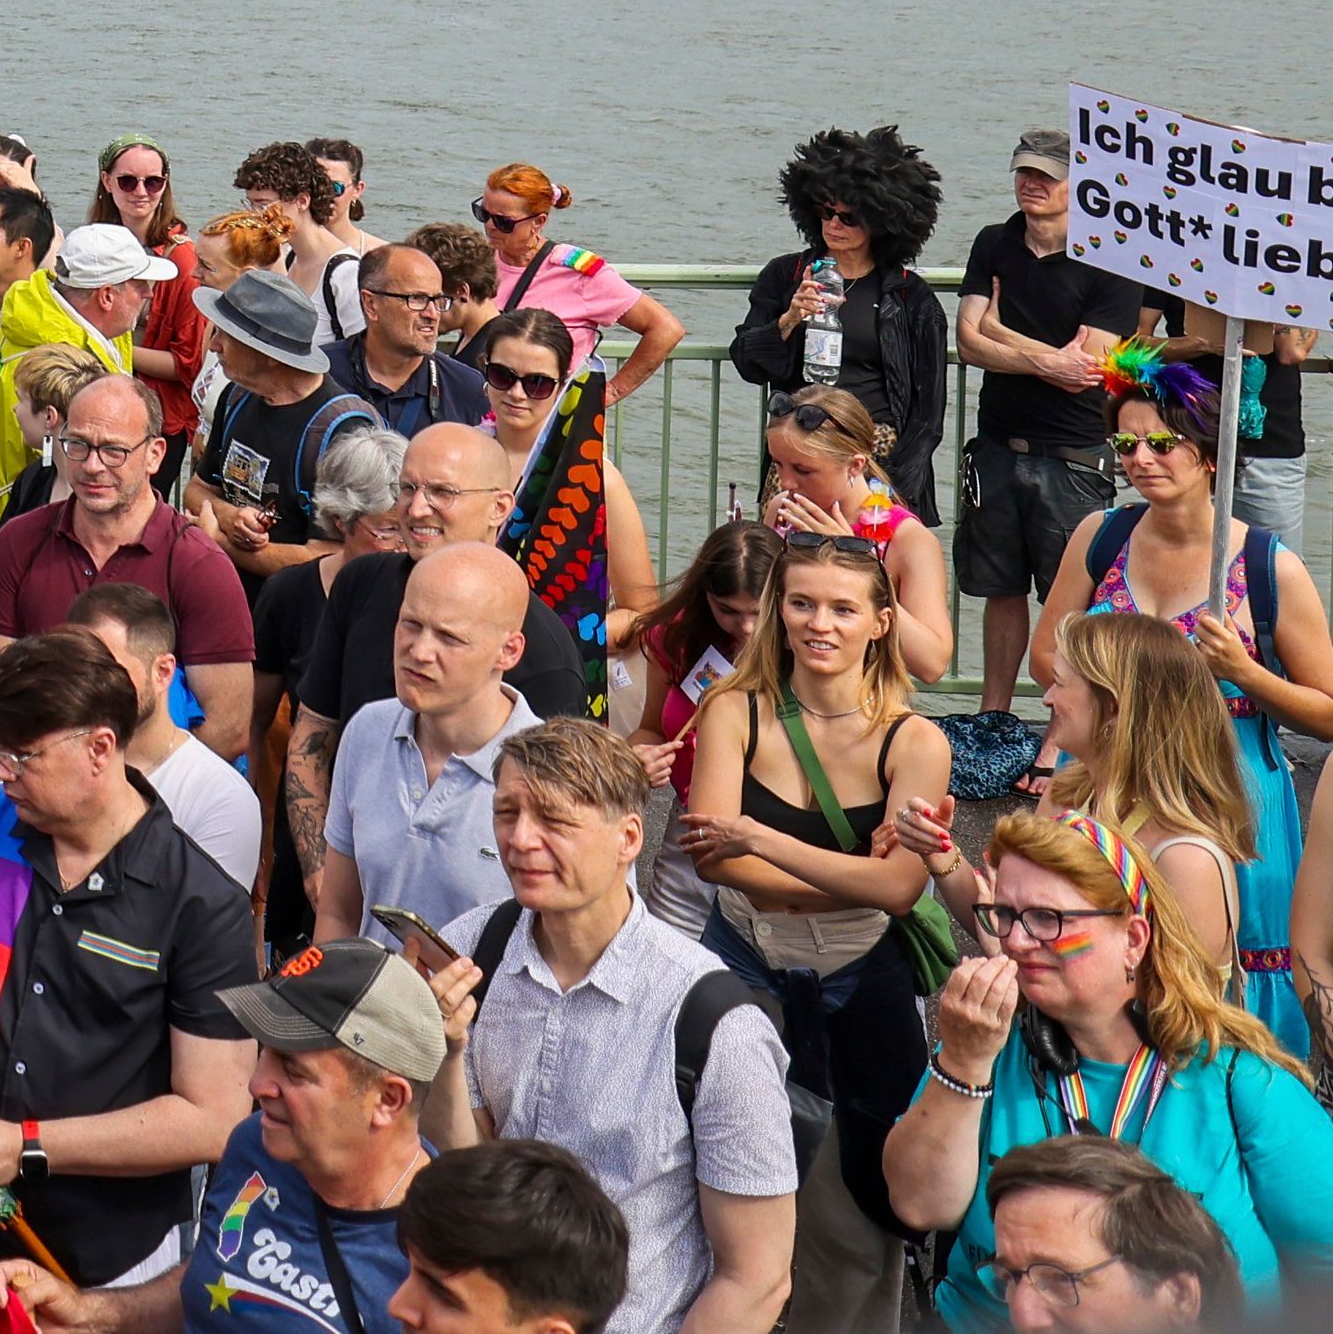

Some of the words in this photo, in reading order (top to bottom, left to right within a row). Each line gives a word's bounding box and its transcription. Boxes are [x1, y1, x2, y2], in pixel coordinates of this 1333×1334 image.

[1078, 107, 1154, 166] Ich
[1223, 224, 1333, 280] lieb
[247, 1228, 340, 1318] Cast
